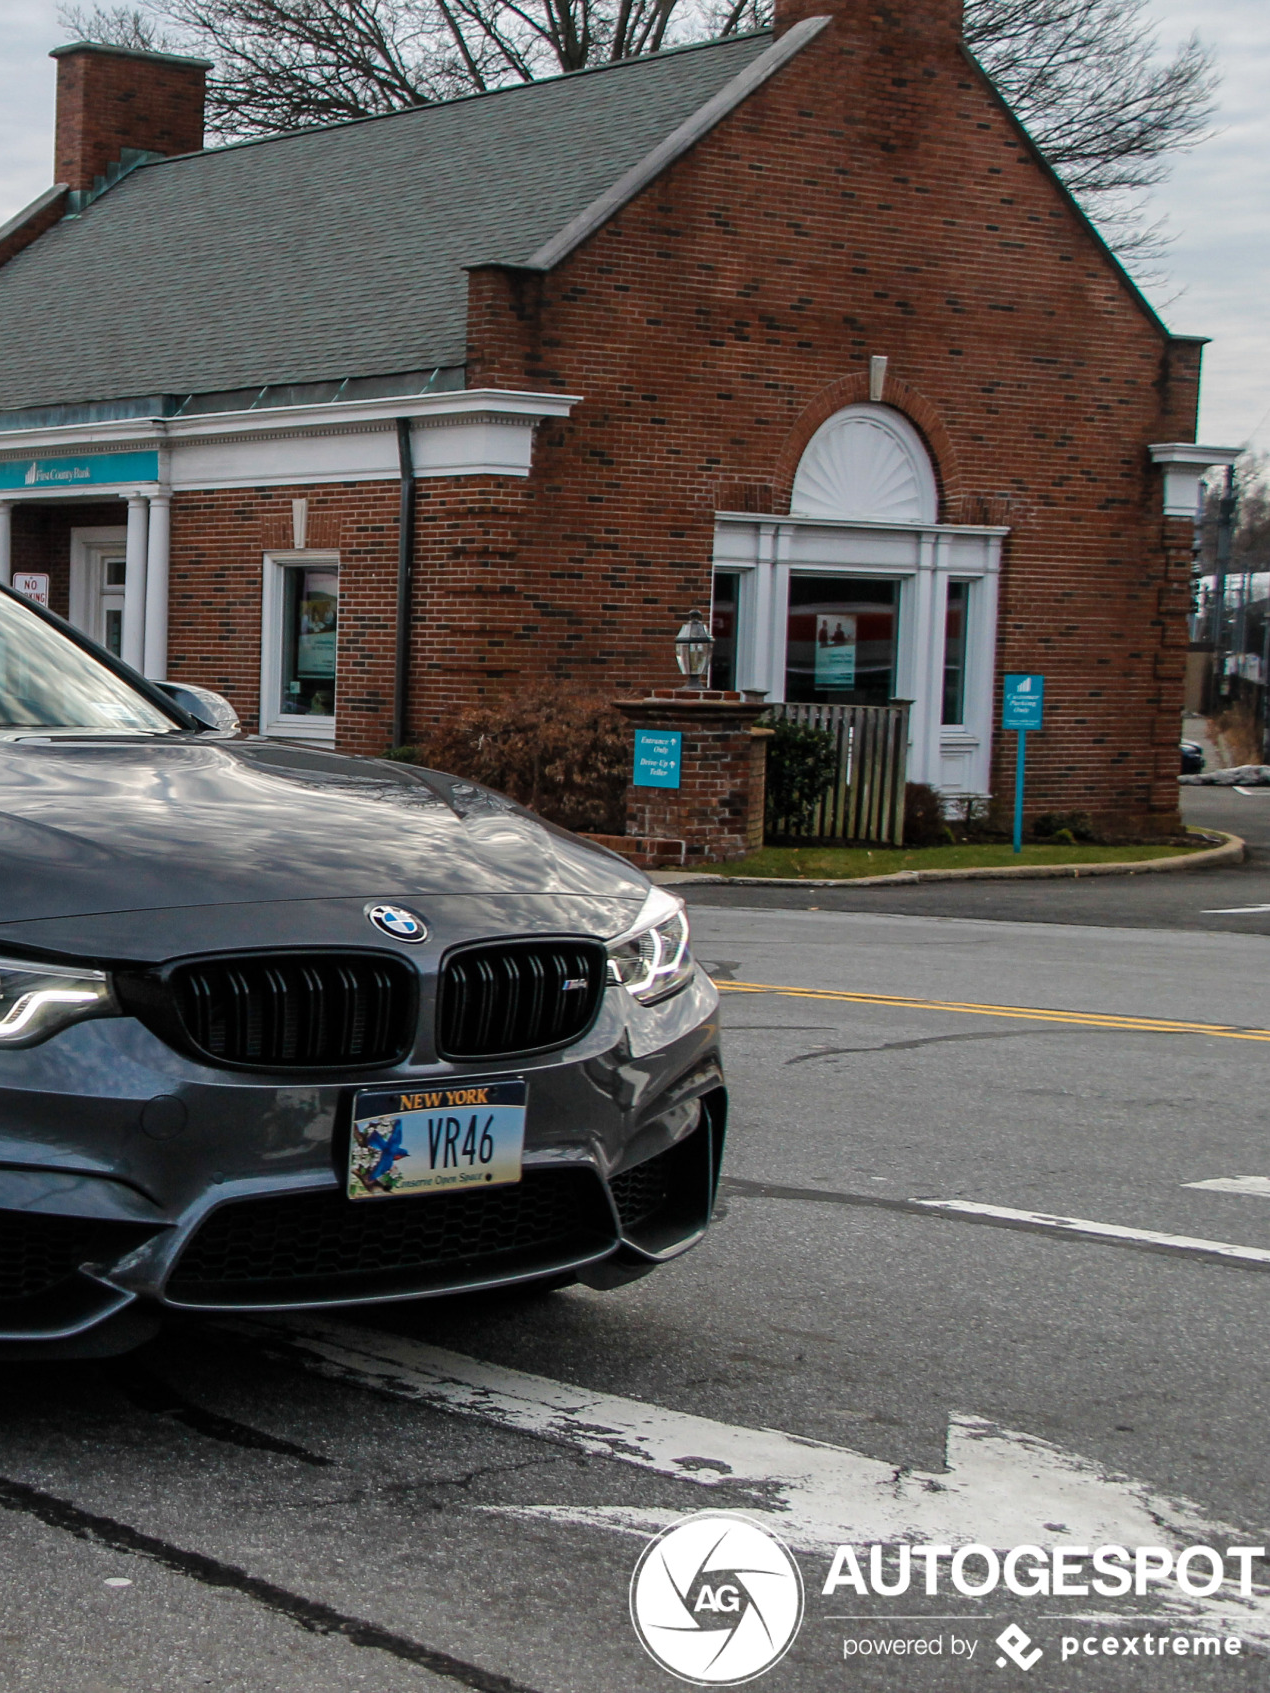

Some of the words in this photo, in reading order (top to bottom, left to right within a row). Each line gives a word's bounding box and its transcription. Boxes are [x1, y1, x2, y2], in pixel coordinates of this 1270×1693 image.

[50, 468, 73, 482] County
[74, 466, 90, 478] Bank
[24, 580, 38, 590] NO
[653, 746, 669, 755] Only
[650, 767, 668, 777] Teller
[400, 1092, 442, 1110] NEW
[446, 1088, 488, 1105] YORK
[428, 1114, 493, 1169] VR46
[434, 1175, 457, 1185] Open
[459, 1172, 483, 1183] Space
